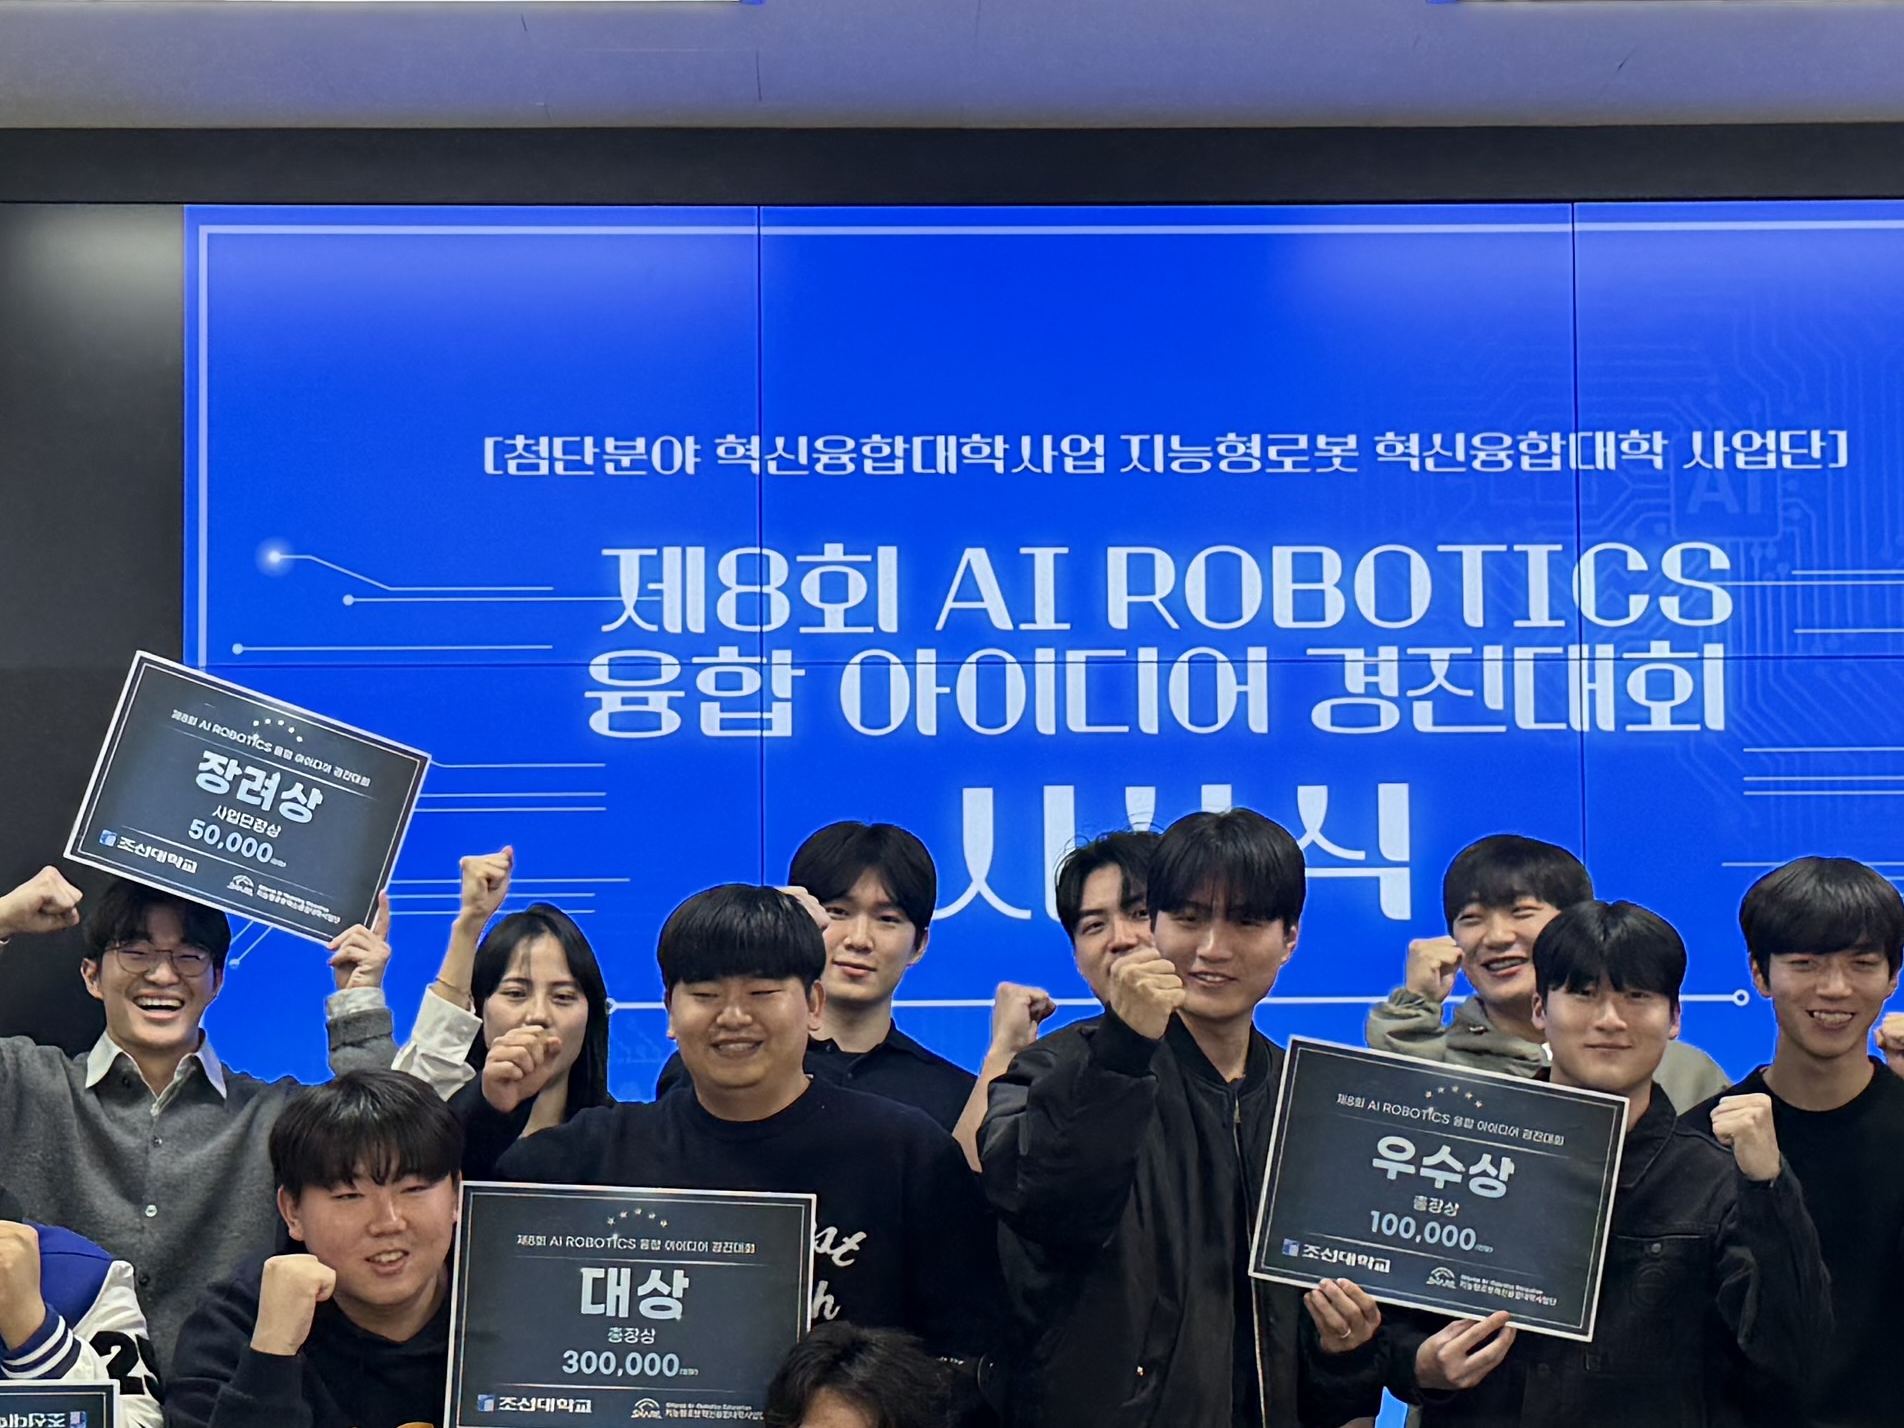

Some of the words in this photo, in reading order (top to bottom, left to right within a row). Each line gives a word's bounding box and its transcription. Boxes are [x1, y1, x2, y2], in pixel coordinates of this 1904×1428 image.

[483, 433, 702, 476] [첨단분야
[1119, 431, 1360, 474] 지능형로봇
[1374, 429, 1668, 472] 혁신융합대학
[1682, 429, 1849, 470] 사업단]
[600, 542, 899, 634] 제8회
[934, 546, 1071, 632] AI
[1106, 541, 1735, 631] ROBOTICS
[584, 645, 806, 740] 융합
[839, 644, 1269, 738] 아이디어
[1305, 639, 1727, 735] 경진대회
[212, 723, 273, 754] ROBOTICS
[195, 750, 324, 824] 장려상
[188, 818, 274, 864] 50,000
[932, 782, 1412, 921] 시식
[1367, 1100, 1381, 1112] AI
[1383, 1102, 1450, 1126] ROBOTICS
[1372, 1135, 1516, 1199] 우수상
[549, 1235, 563, 1249] AI
[565, 1236, 637, 1251] ROBOTICS
[1369, 1209, 1477, 1252] 100,000
[580, 1266, 690, 1321] 대상
[562, 1350, 680, 1378] 300,000
[498, 1396, 593, 1414] 조선대학교
